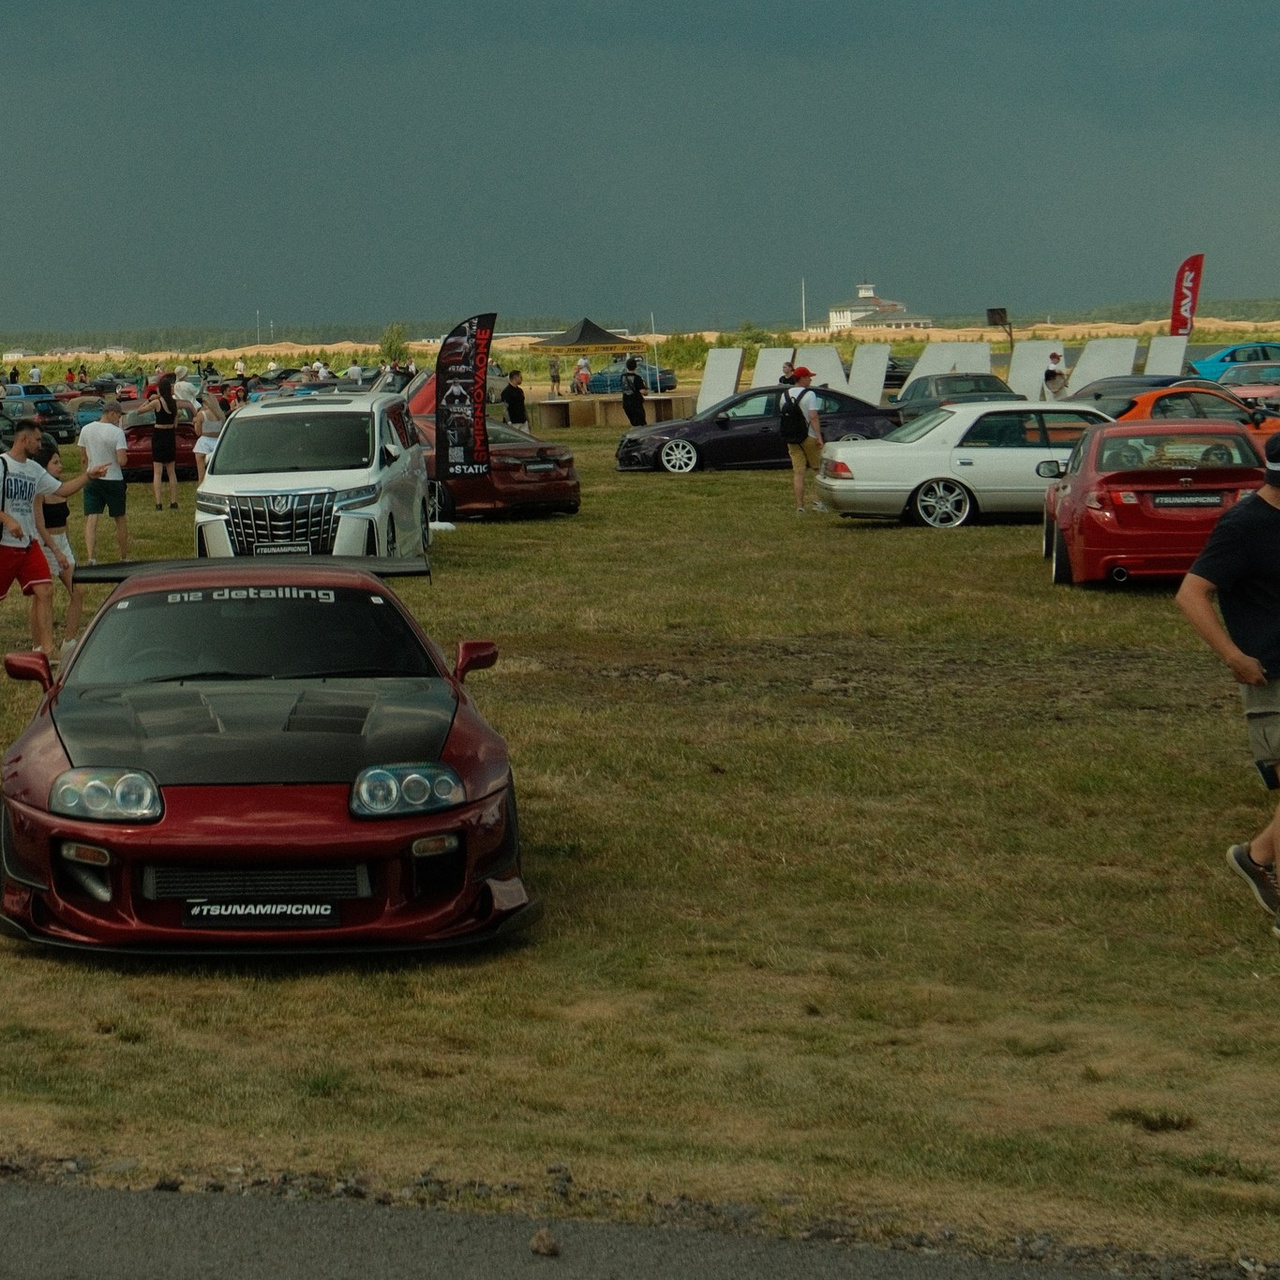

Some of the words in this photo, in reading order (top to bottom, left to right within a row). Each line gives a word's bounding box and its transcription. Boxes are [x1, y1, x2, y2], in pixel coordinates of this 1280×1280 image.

[1178, 270, 1195, 334] LAVR
[167, 591, 203, 603] 812
[212, 587, 335, 603] detailing
[190, 904, 332, 916] #TSUNAMIPICNIC
